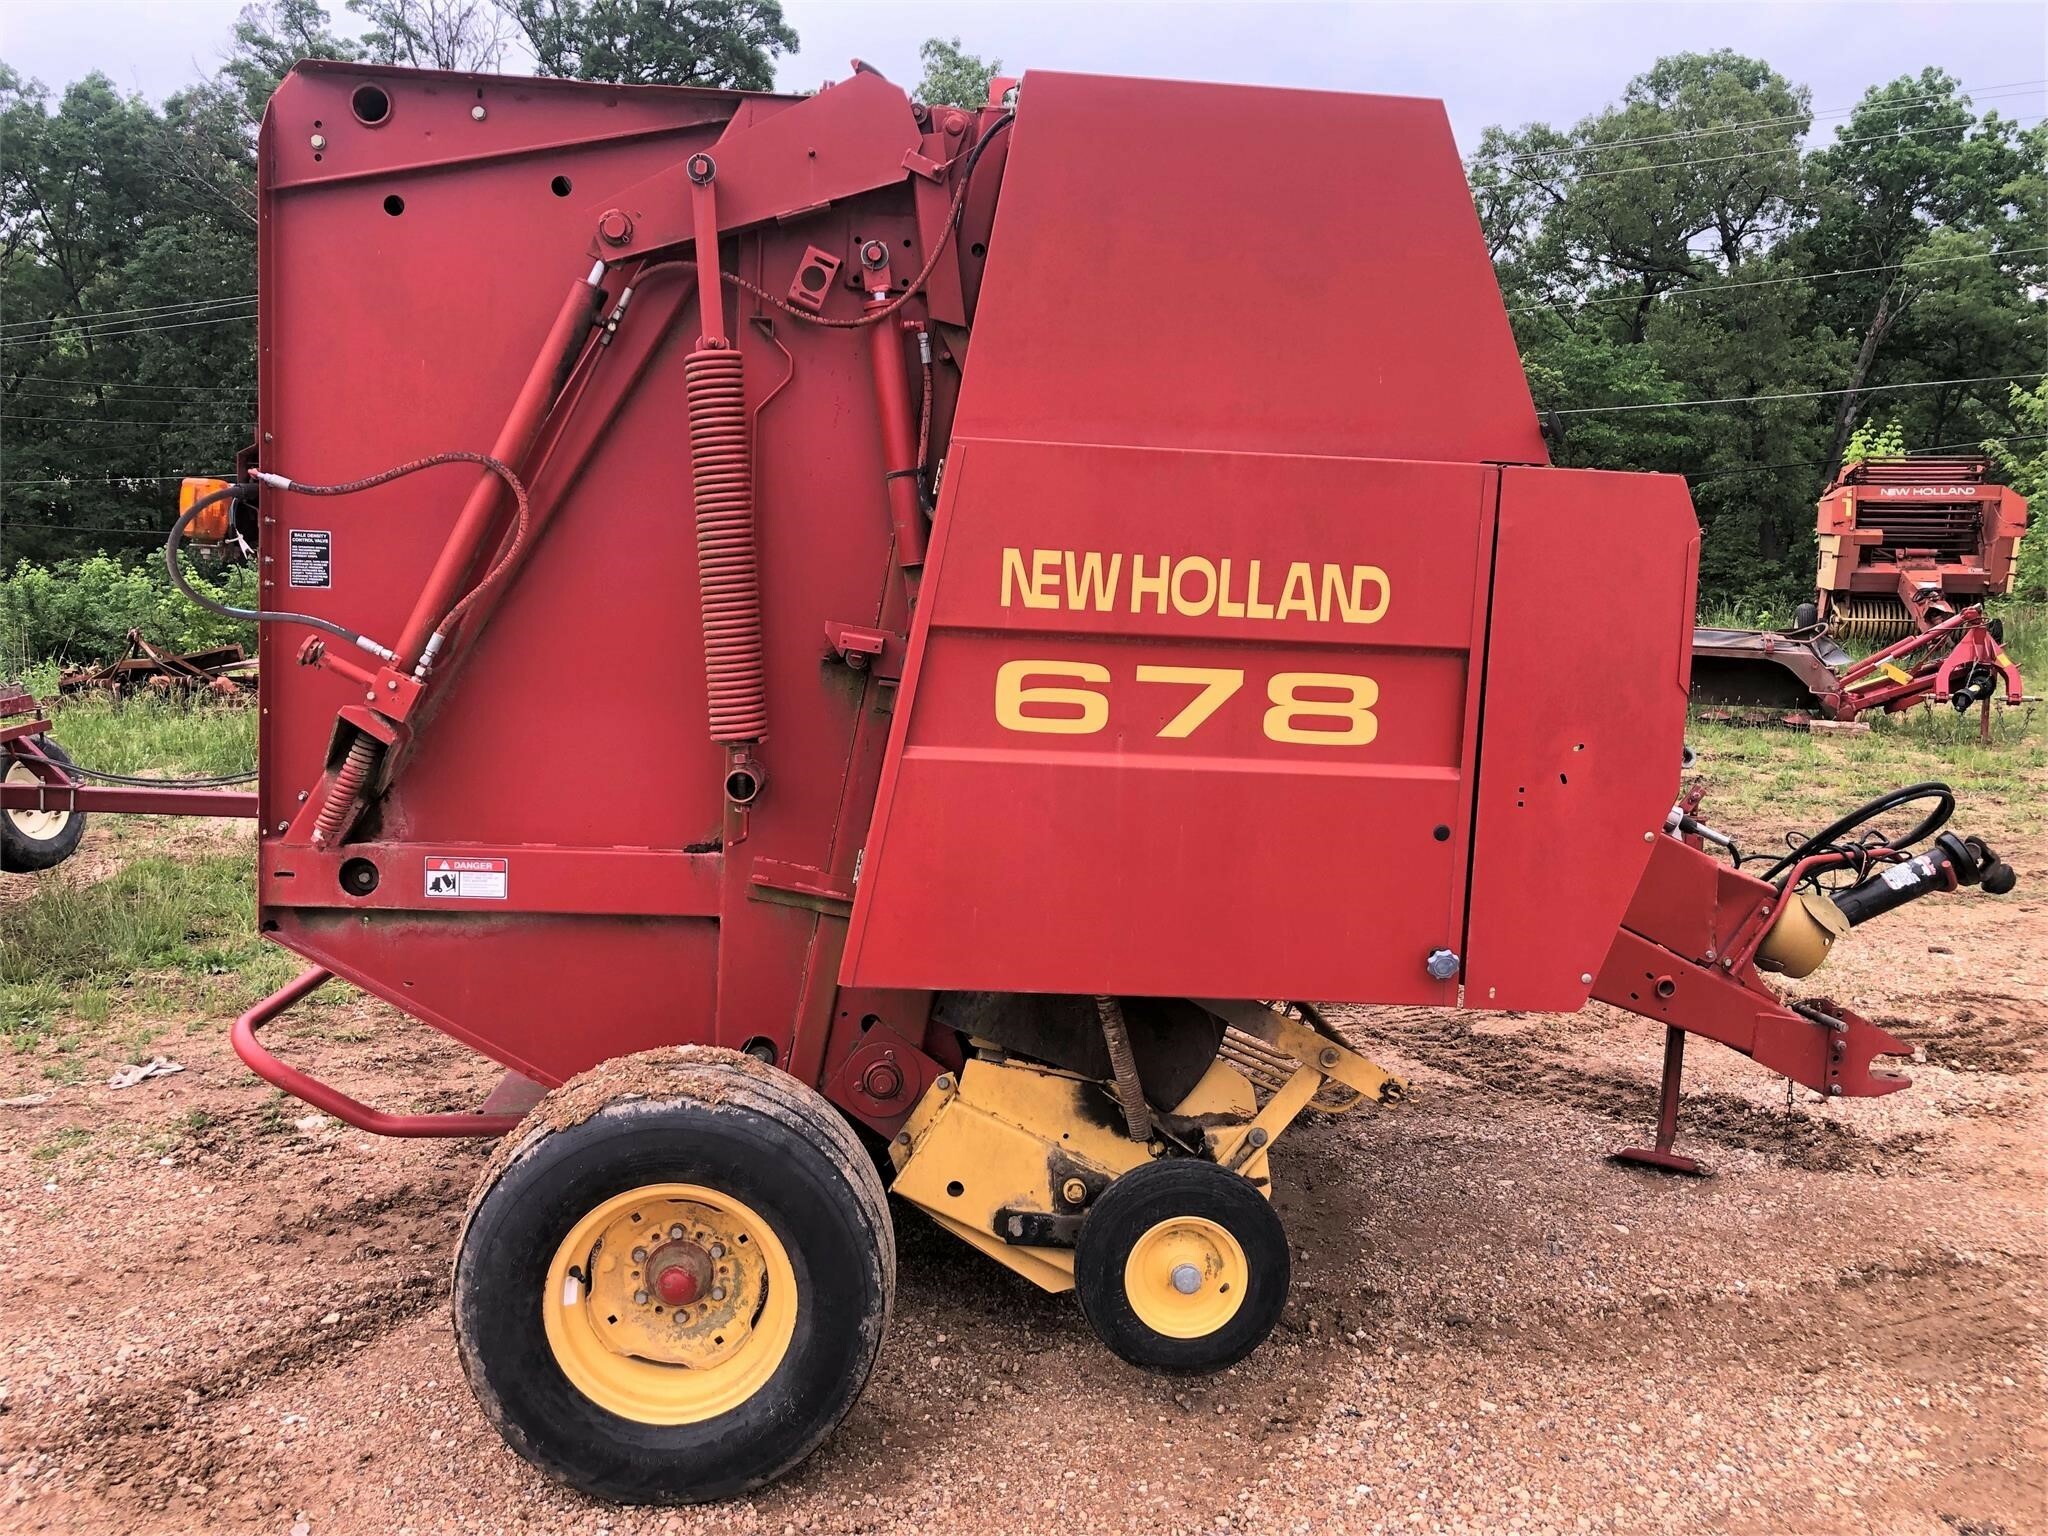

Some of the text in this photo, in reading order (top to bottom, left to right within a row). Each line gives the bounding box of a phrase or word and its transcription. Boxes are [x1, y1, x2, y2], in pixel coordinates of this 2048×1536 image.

[1913, 488, 1975, 496] HOLLAND
[1000, 547, 1391, 624] NEW HOLLAND
[995, 659, 1380, 746] 678
[453, 861, 493, 870] DANGER
